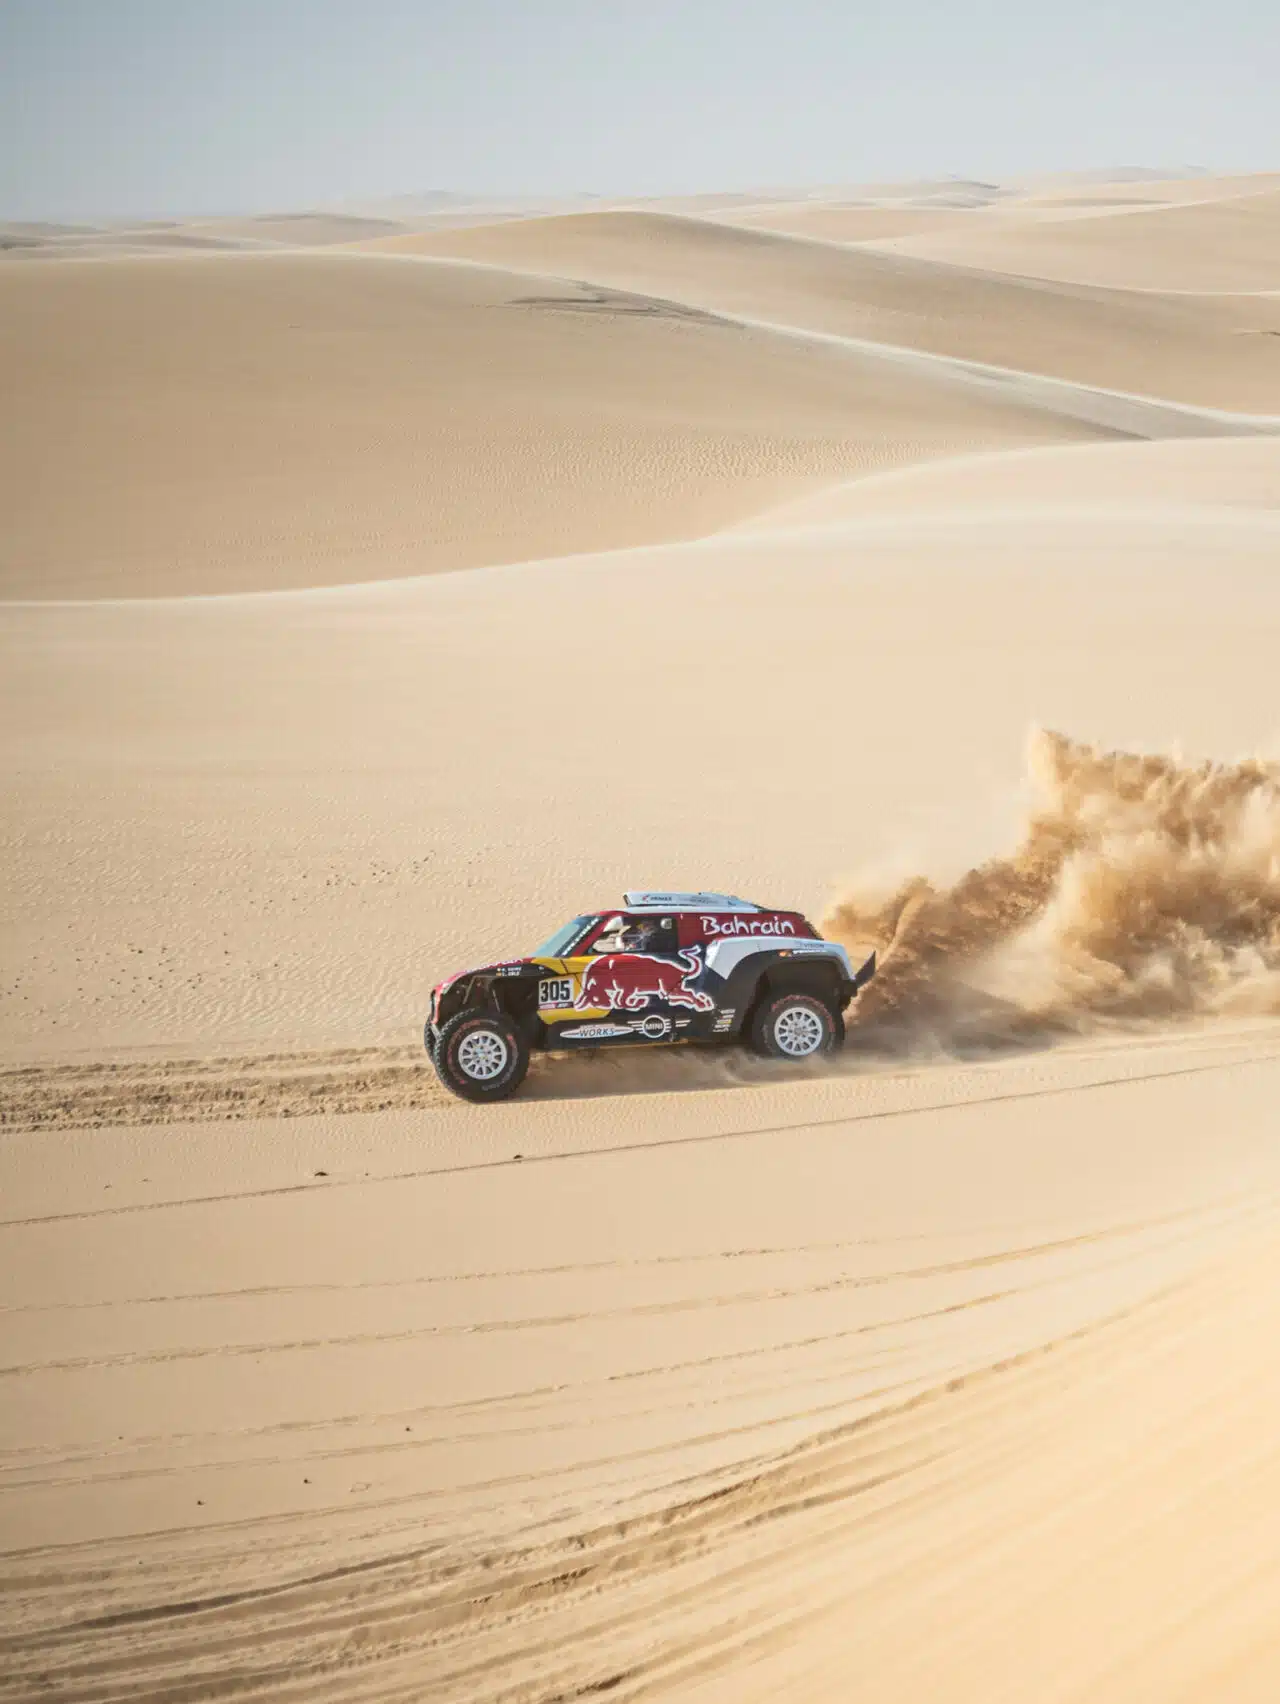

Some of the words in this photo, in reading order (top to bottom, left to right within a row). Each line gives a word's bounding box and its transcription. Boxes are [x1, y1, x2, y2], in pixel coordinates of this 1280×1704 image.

[700, 915, 795, 936] Bahrain
[540, 980, 571, 1003] 305
[580, 1028, 616, 1037] WORKS
[645, 1023, 663, 1031] MINI
